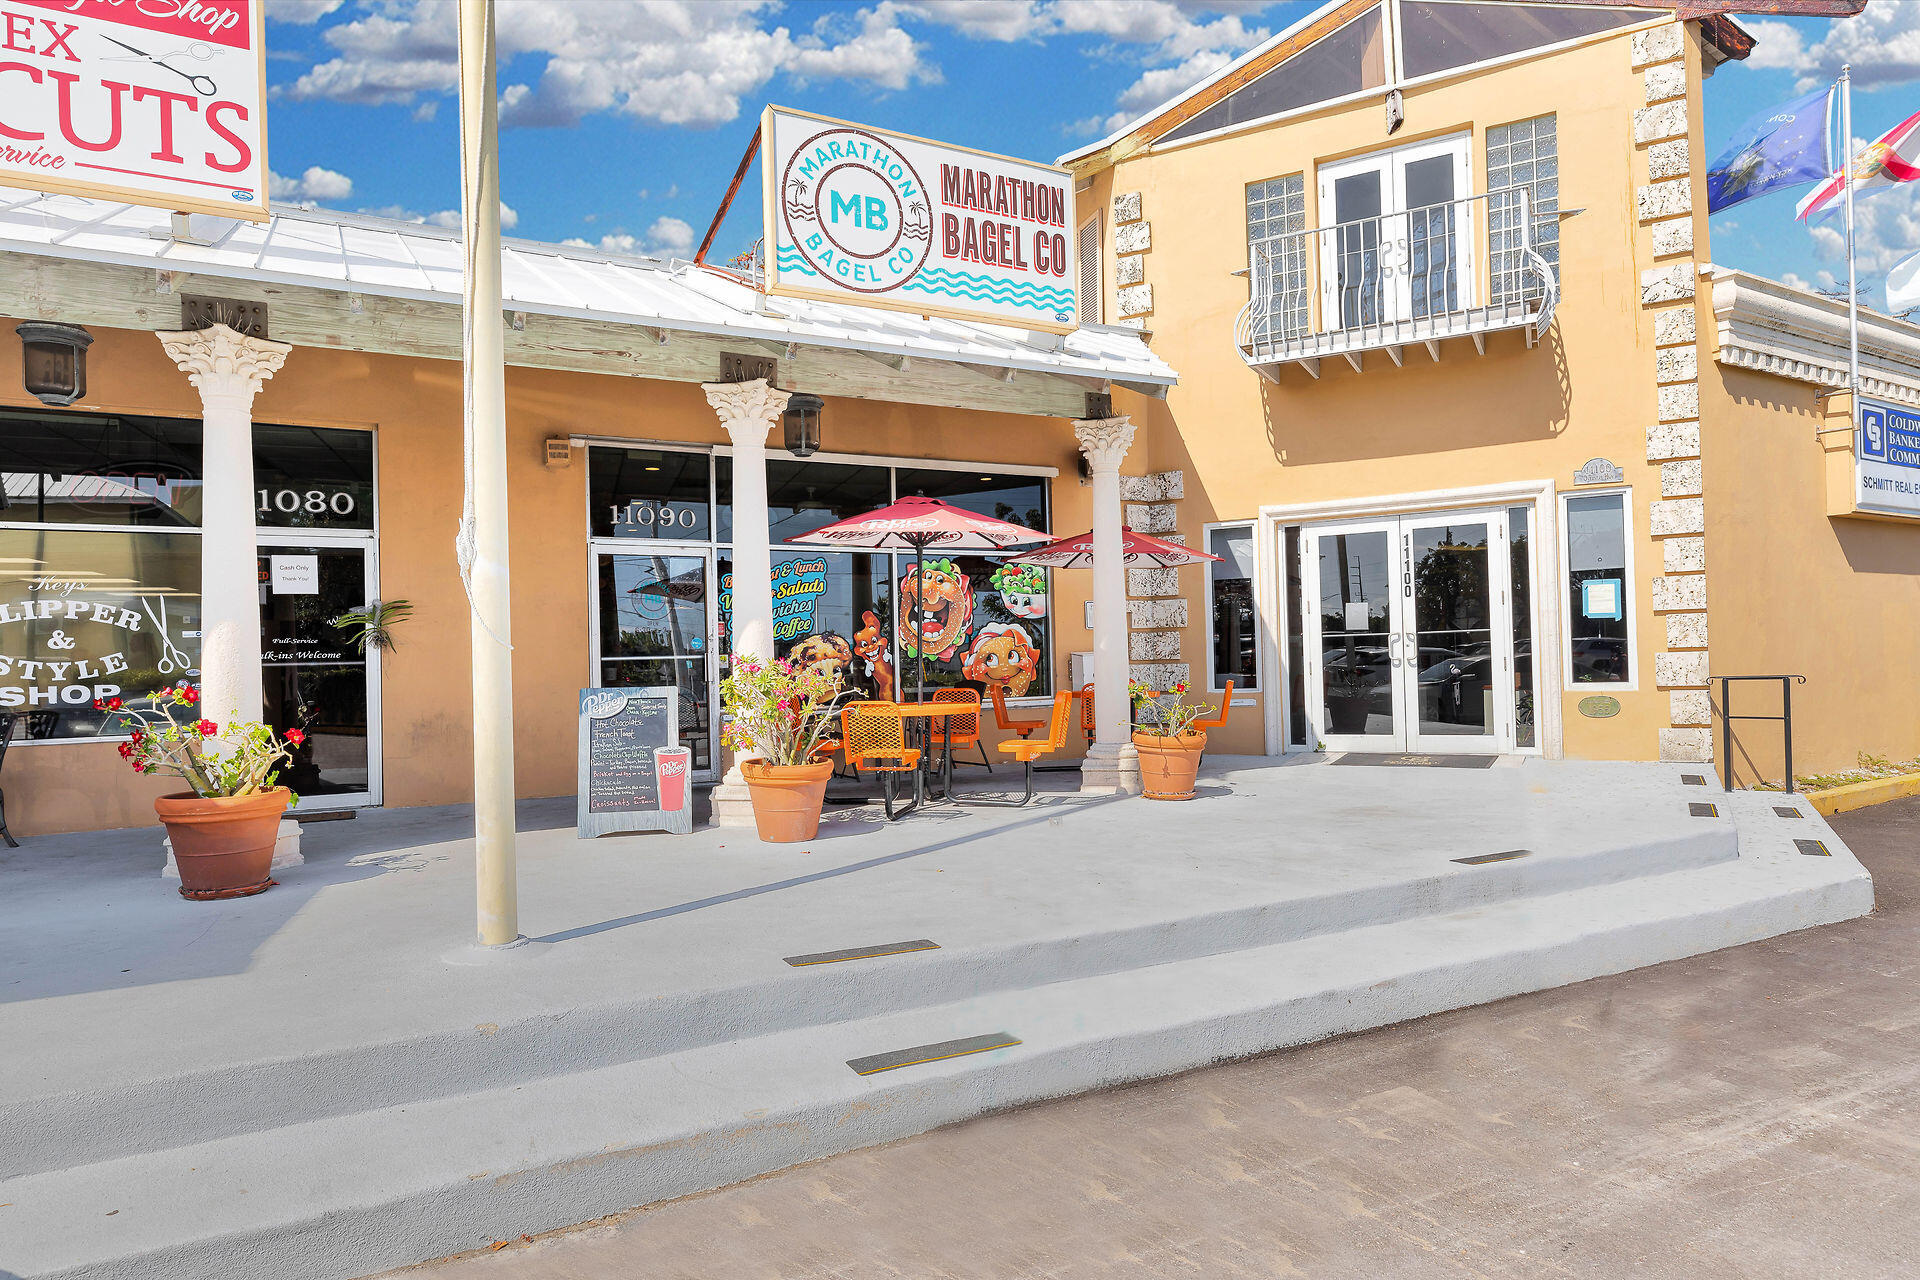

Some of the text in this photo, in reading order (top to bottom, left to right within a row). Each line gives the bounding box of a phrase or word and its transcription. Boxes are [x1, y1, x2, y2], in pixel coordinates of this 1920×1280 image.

[1, 11, 81, 63] EX
[0, 61, 252, 173] CUTS
[0, 145, 66, 169] rvice
[798, 139, 917, 199] MARATHON
[941, 163, 1066, 228] MARATHON
[830, 189, 888, 231] MB
[942, 212, 1067, 277] BAGEL CO
[805, 231, 914, 283] BAGEL CO
[70, 470, 184, 505] OPEN
[1863, 476, 1893, 491] SCHMITT
[1895, 480, 1913, 494] REAL
[257, 489, 354, 515] 1080
[609, 504, 696, 528] 11090
[295, 564, 310, 572] Only
[782, 564, 792, 577] &
[794, 560, 825, 576] Lunch
[1403, 533, 1412, 598] 11100
[28, 576, 89, 597] Keys
[777, 578, 824, 599] Salads
[0, 600, 141, 631] LIPPER
[773, 600, 813, 619] wiches
[773, 617, 811, 637] Coffee
[47, 630, 76, 649] &
[0, 652, 128, 681] STYLE
[295, 650, 342, 659] Welcome
[0, 684, 121, 706] SHOP
[584, 695, 624, 716] Pepper
[592, 728, 618, 740] French
